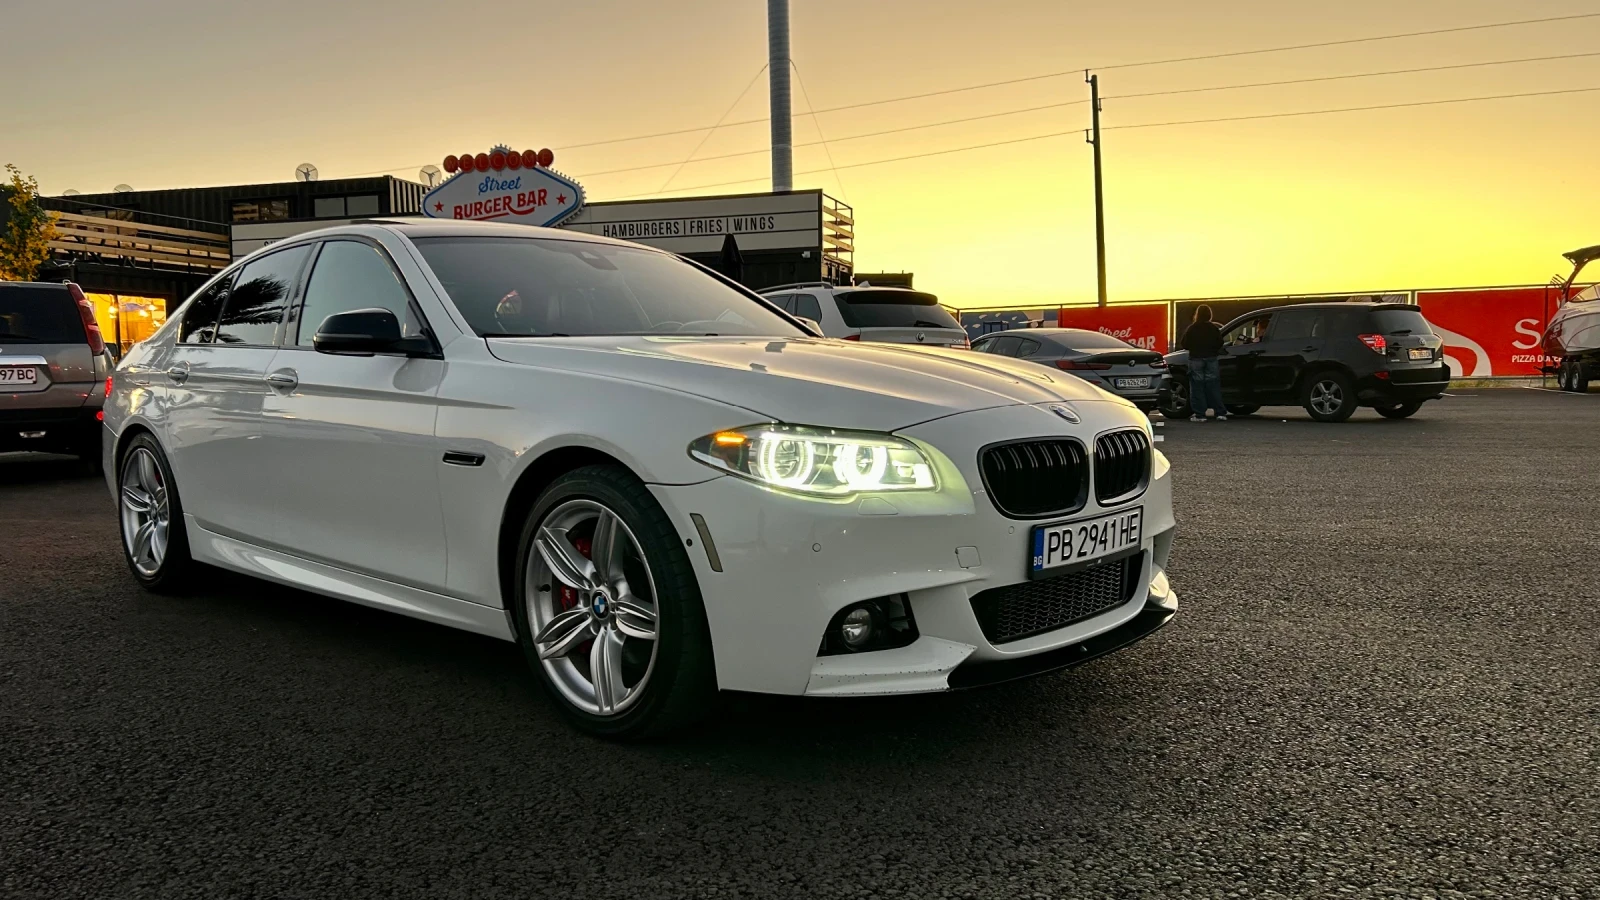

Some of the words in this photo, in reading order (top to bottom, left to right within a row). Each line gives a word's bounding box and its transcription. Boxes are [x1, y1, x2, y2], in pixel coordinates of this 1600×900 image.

[445, 150, 551, 171] WELCOME
[478, 176, 521, 195] Street
[453, 195, 513, 219] BURGER
[517, 189, 547, 208] BAR
[603, 221, 680, 237] HAMBURGERS
[690, 219, 722, 234] FRIES
[733, 216, 775, 231] WINGS
[1511, 354, 1536, 363] PIZZA
[17, 369, 34, 380] BC
[1047, 529, 1073, 564] PB
[1077, 519, 1117, 558] 2941
[1120, 511, 1139, 547] HE
[1033, 555, 1043, 567] BG
